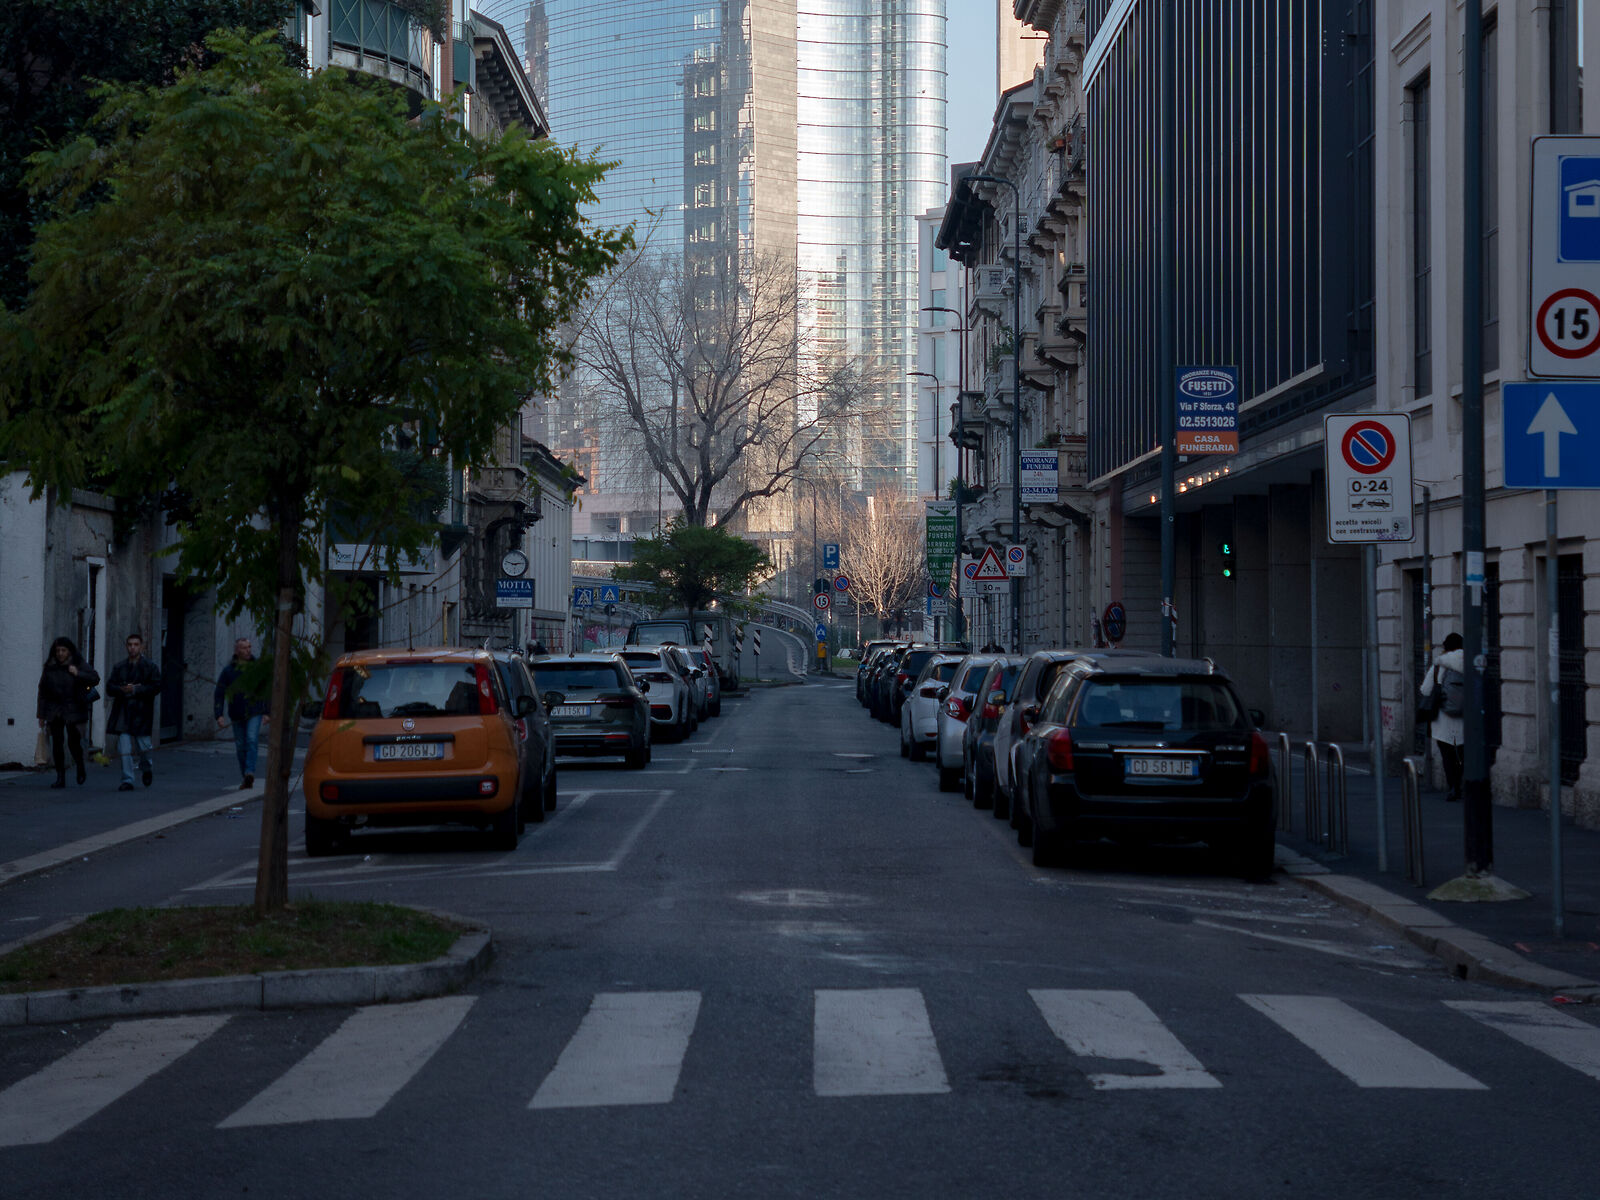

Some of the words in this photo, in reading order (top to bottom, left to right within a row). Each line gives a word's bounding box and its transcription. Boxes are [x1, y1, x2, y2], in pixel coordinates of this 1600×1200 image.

[1553, 307, 1590, 341] 15
[1187, 381, 1227, 391] FUSETTI
[1180, 402, 1192, 411] Via
[1193, 402, 1198, 411] F
[1199, 402, 1224, 412] Sforza,
[1225, 402, 1235, 411] 43
[1179, 416, 1235, 427] 02.5513026
[1194, 435, 1220, 443] CASA
[1179, 444, 1235, 452] FUNERARIA
[1351, 480, 1389, 492] 0-24
[826, 545, 836, 558] P
[498, 580, 532, 589] MOTTA
[1133, 760, 1148, 773] CD
[1152, 760, 1191, 774] 581JF
